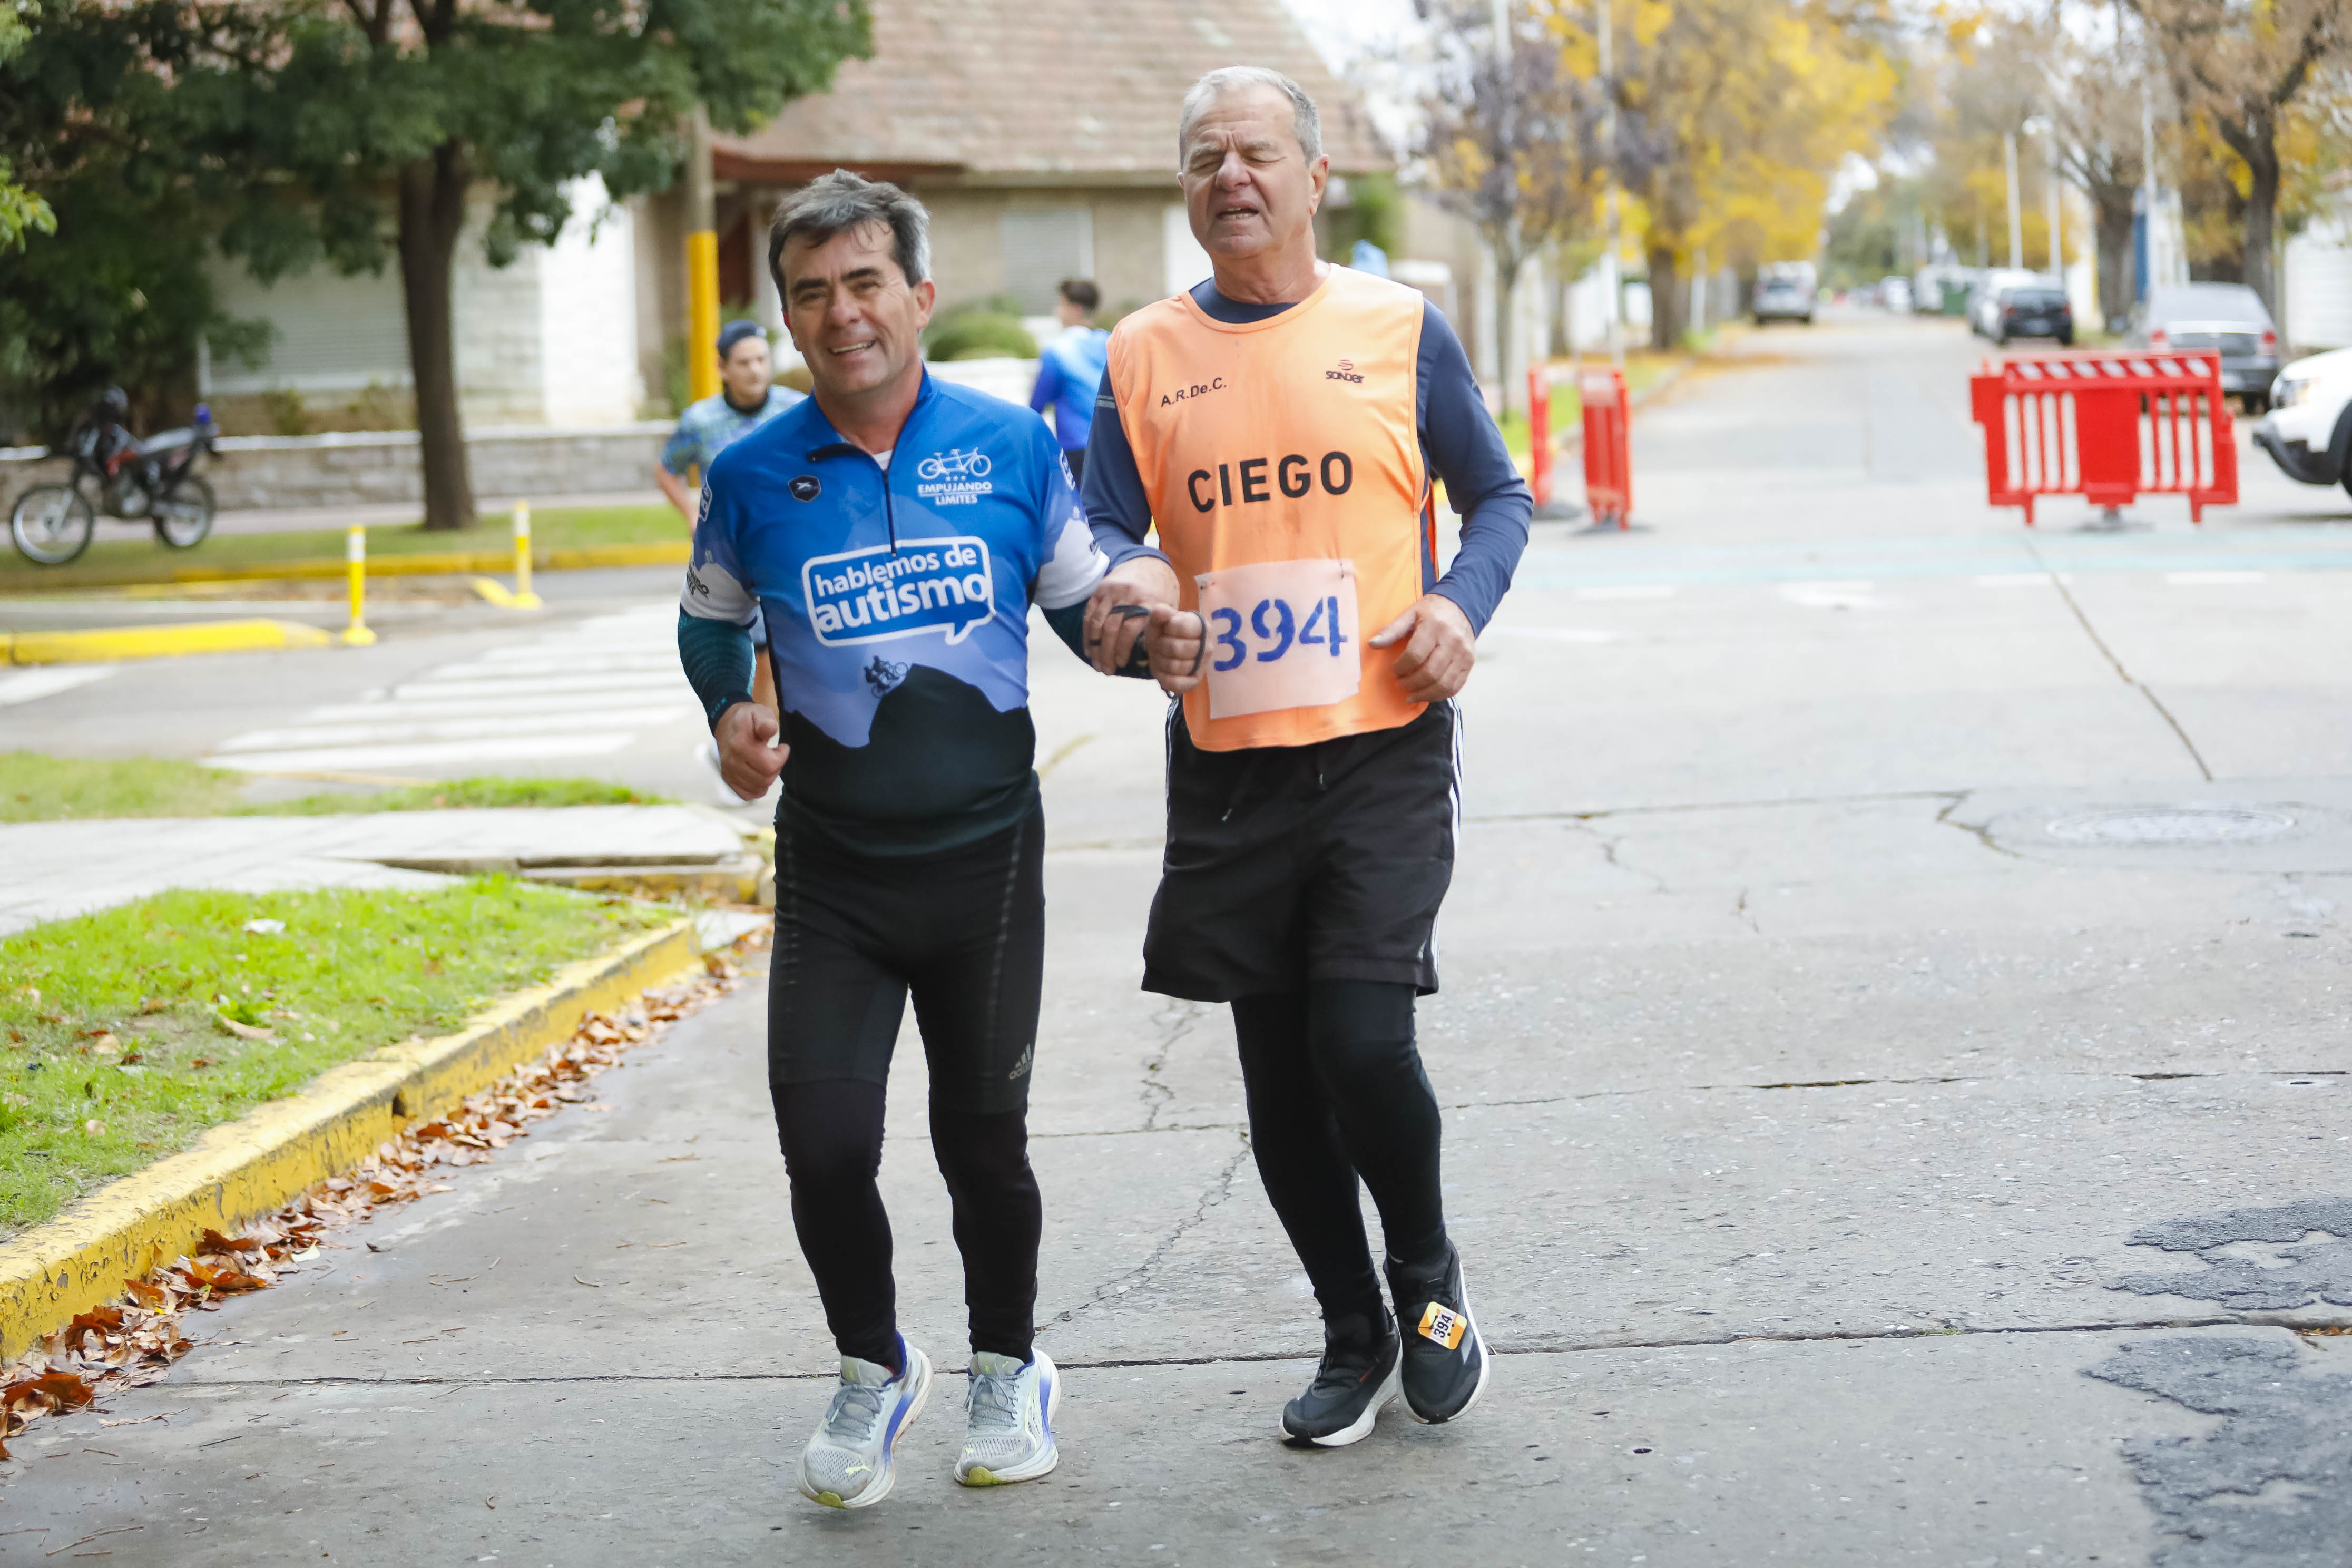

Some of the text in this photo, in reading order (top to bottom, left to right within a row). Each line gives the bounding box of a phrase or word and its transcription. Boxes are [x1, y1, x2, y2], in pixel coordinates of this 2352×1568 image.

[1161, 377, 1227, 408] A.R.De.C.
[918, 481, 993, 493] EMPUJANDO
[935, 494, 978, 506] LIMITES
[1188, 451, 1353, 513] CIEGO
[815, 543, 977, 597] hablemos de
[815, 573, 989, 633] autismo
[1211, 596, 1348, 672] 394
[1434, 1314, 1452, 1338] 394
